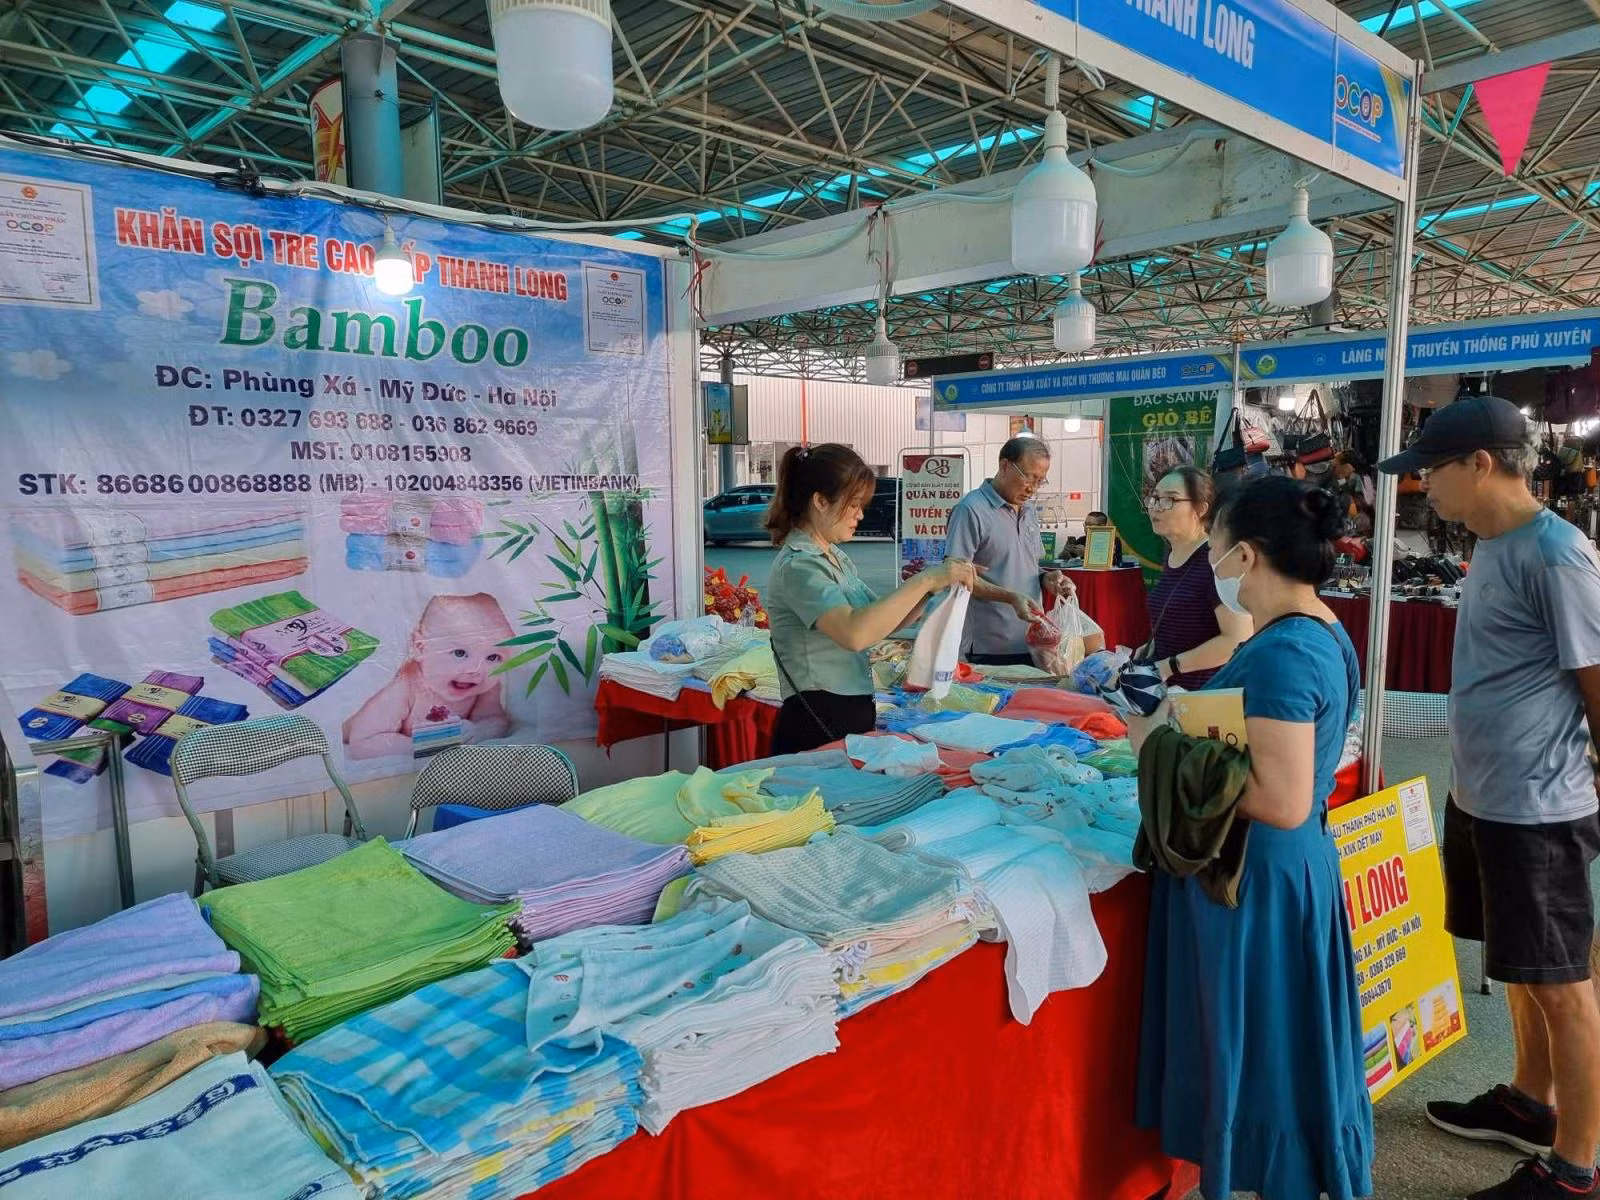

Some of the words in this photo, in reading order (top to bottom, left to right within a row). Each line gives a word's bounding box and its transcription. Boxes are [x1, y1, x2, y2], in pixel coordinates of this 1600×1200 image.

[1203, 0, 1255, 69] LONG
[1335, 74, 1383, 127] OCOP
[6, 219, 54, 233] OCOP
[115, 207, 205, 255] KHĂN
[212, 221, 265, 268] SỢI
[268, 229, 320, 270] TRE
[324, 238, 376, 277] CAO
[436, 255, 509, 295] THANH
[514, 265, 568, 301] LONG
[219, 277, 529, 367] Bamboo
[1342, 348, 1372, 364] LÀNG
[1464, 332, 1507, 354] THỐNG
[1511, 330, 1540, 350] PHÚ
[1543, 327, 1592, 347] XUYÊN
[155, 364, 212, 390] ĐC:
[223, 368, 315, 399] Phùng
[323, 374, 357, 396] Xá
[379, 378, 415, 403] Mỹ
[421, 381, 467, 402] Đức
[488, 386, 516, 406] Hà
[523, 387, 557, 412] Nội
[188, 404, 233, 427] ĐT:
[240, 408, 301, 428] 0327
[308, 410, 349, 430] 693
[355, 412, 393, 431] 688
[411, 415, 447, 433] 036
[453, 417, 489, 435] 862
[493, 418, 538, 436] 9669
[1142, 408, 1179, 428] GIÒ
[1184, 406, 1213, 425] BÊ
[290, 441, 344, 461] MST:
[18, 473, 87, 496] STK:
[319, 474, 364, 493] (MB)
[925, 459, 950, 478] QB
[914, 523, 928, 535] VÀ
[1356, 856, 1409, 925] LONG
